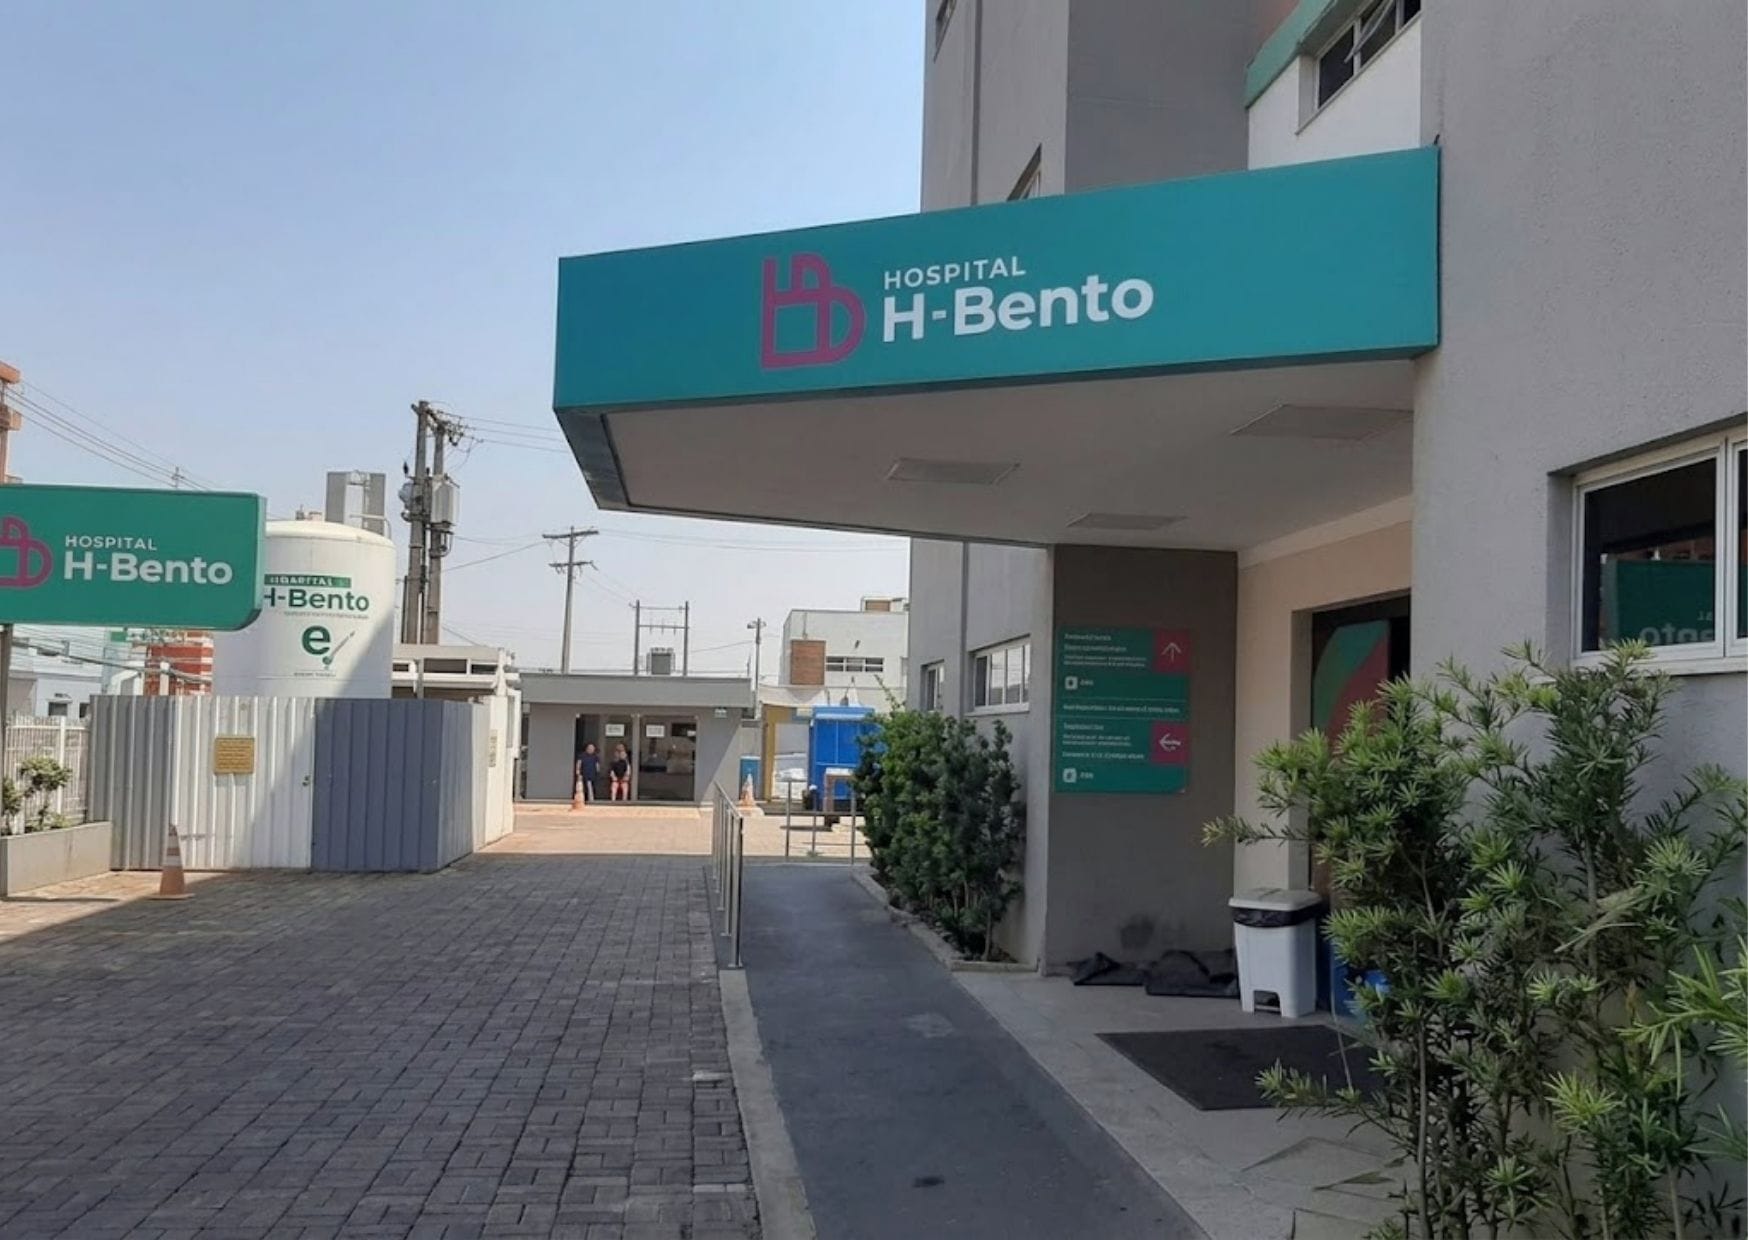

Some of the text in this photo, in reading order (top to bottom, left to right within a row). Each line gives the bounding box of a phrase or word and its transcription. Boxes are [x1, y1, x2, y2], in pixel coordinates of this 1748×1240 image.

[883, 255, 1027, 290] HOSPITAL
[883, 273, 1155, 343] H-Bento
[65, 535, 158, 551] HOSPITAL
[63, 550, 234, 585] H-Bento
